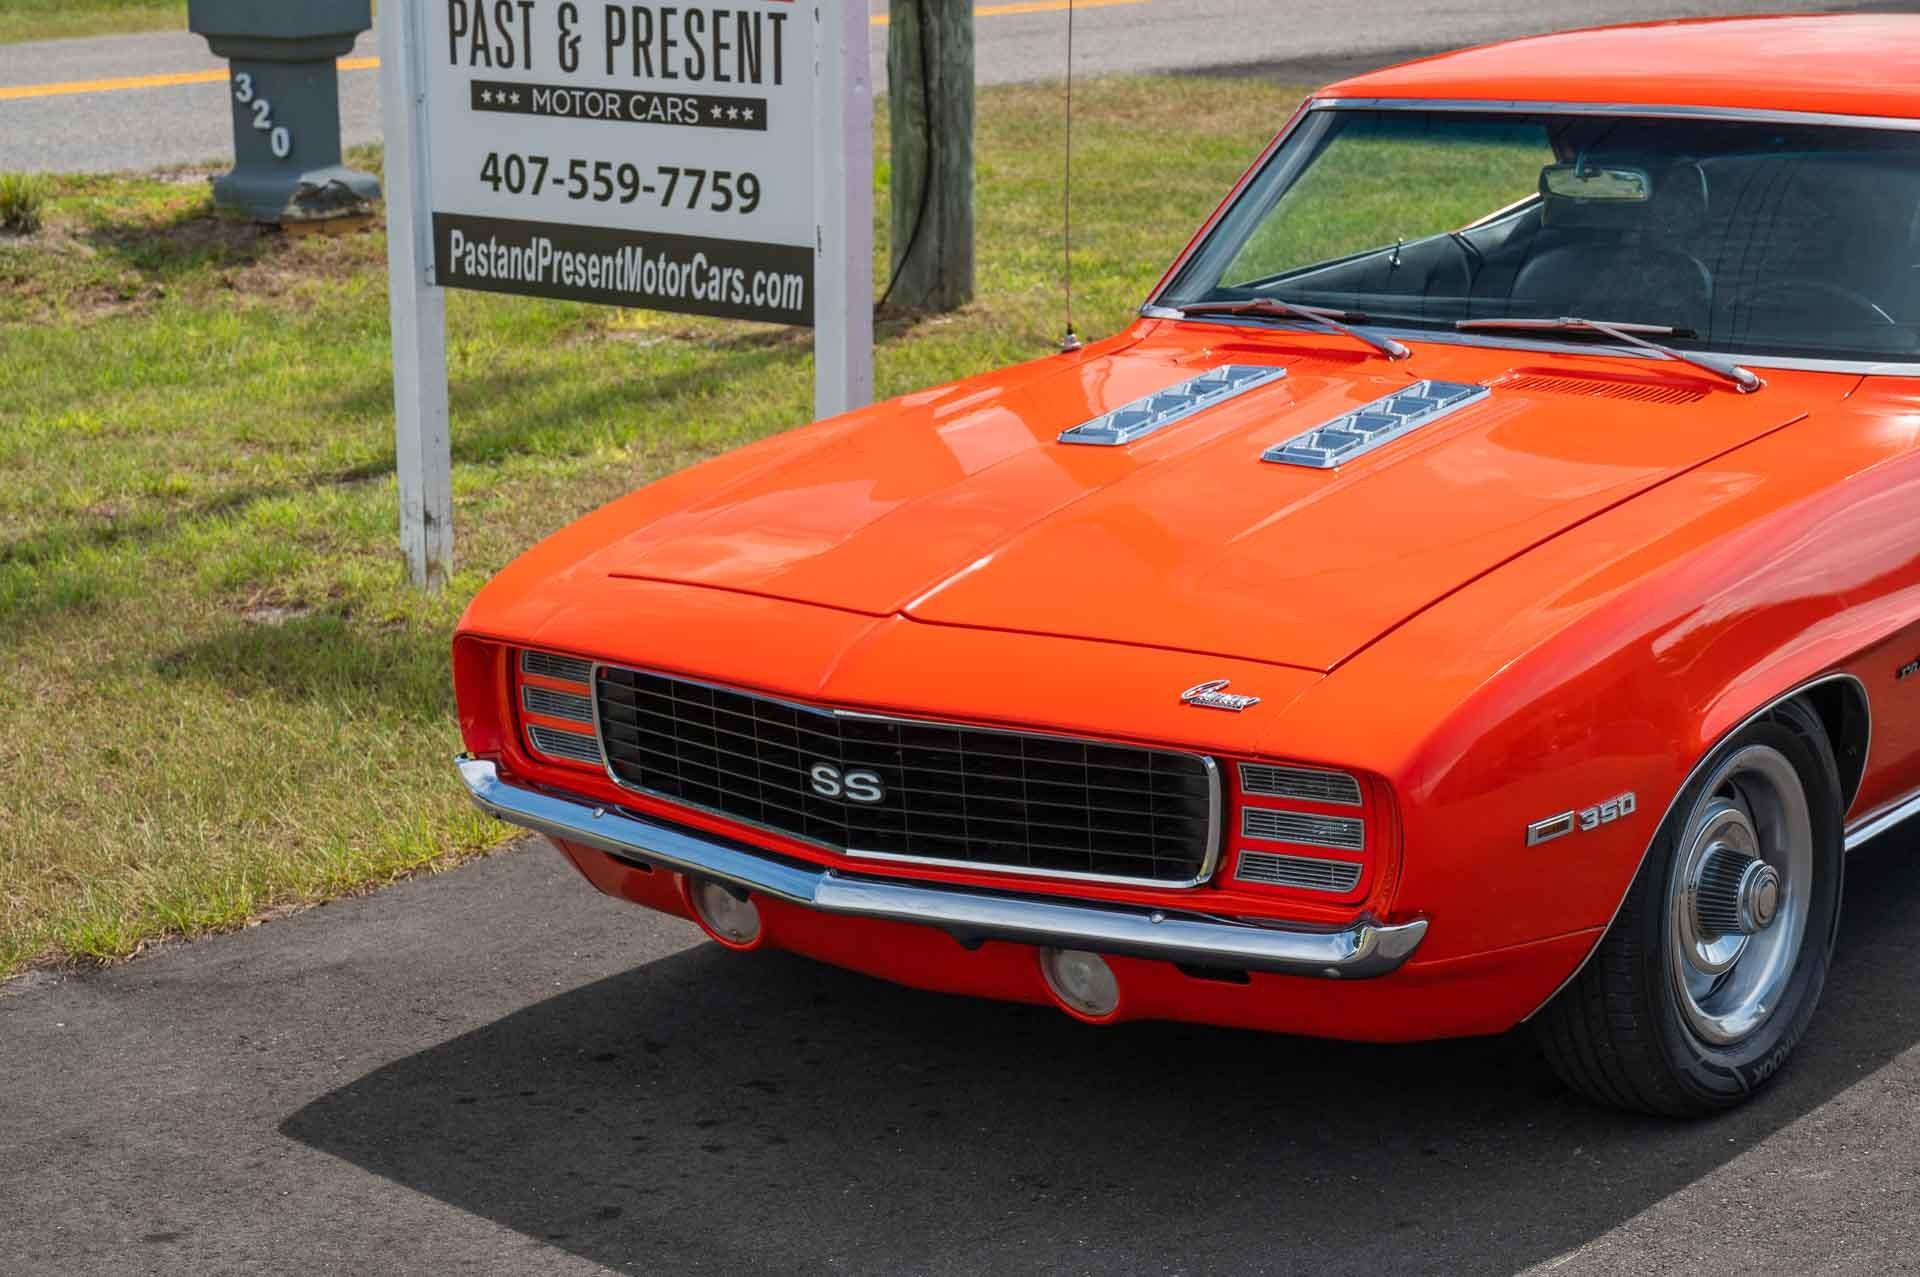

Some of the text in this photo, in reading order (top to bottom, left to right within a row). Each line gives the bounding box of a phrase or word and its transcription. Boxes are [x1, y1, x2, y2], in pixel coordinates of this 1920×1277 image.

[448, 0, 788, 85] PAST & PRESENT
[531, 87, 700, 125] MOTOR CARS
[480, 152, 761, 215] 407-559-7759
[450, 229, 804, 311] PastandPresentMotorCars.com
[811, 765, 882, 801] SS
[1579, 791, 1636, 832] 350
